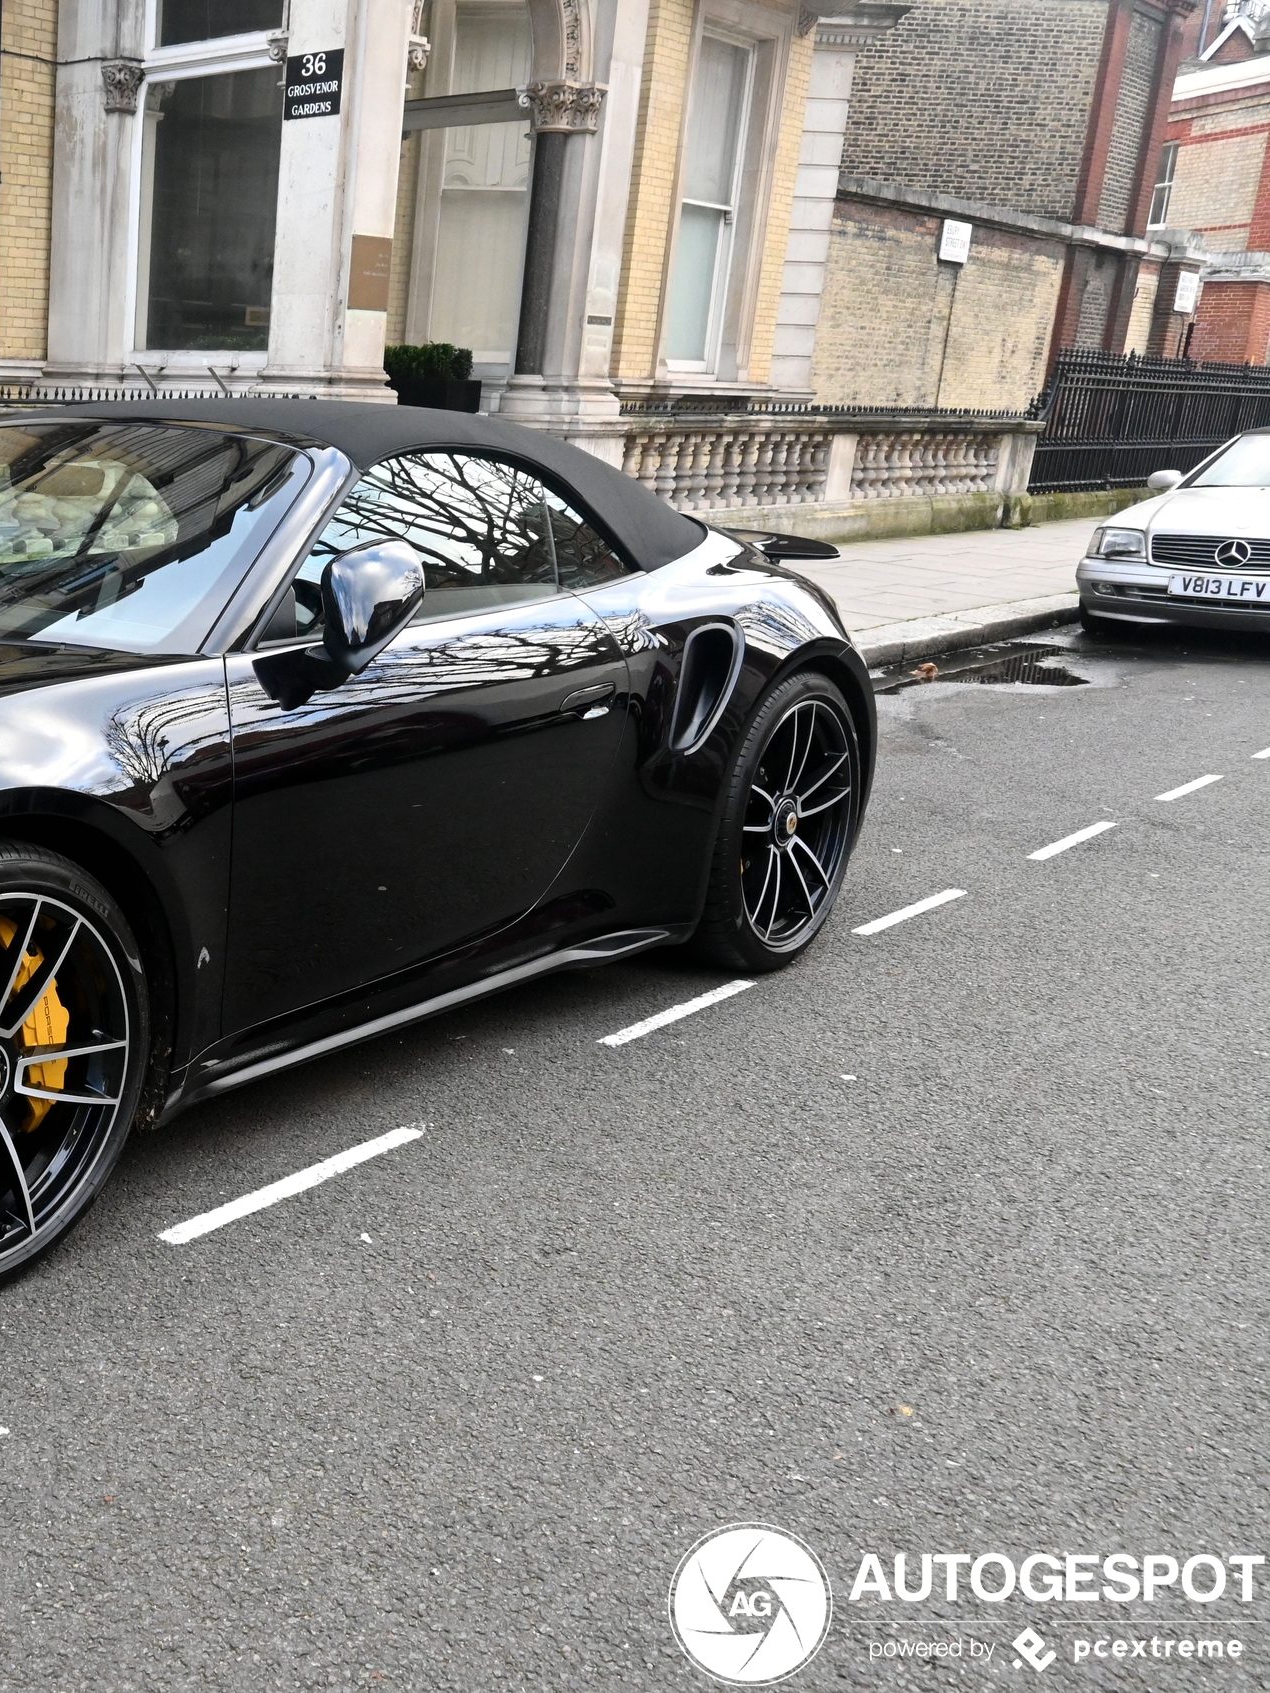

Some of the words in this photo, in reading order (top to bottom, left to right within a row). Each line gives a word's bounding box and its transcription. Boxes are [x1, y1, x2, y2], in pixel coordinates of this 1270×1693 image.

[301, 52, 327, 77] 36
[287, 80, 339, 97] GROSVENOR
[291, 101, 332, 116] GARDENS
[1182, 577, 1222, 595] V813
[1227, 581, 1266, 598] LFV
[69, 879, 110, 917] PIRELLI
[43, 996, 56, 1064] PORSC
